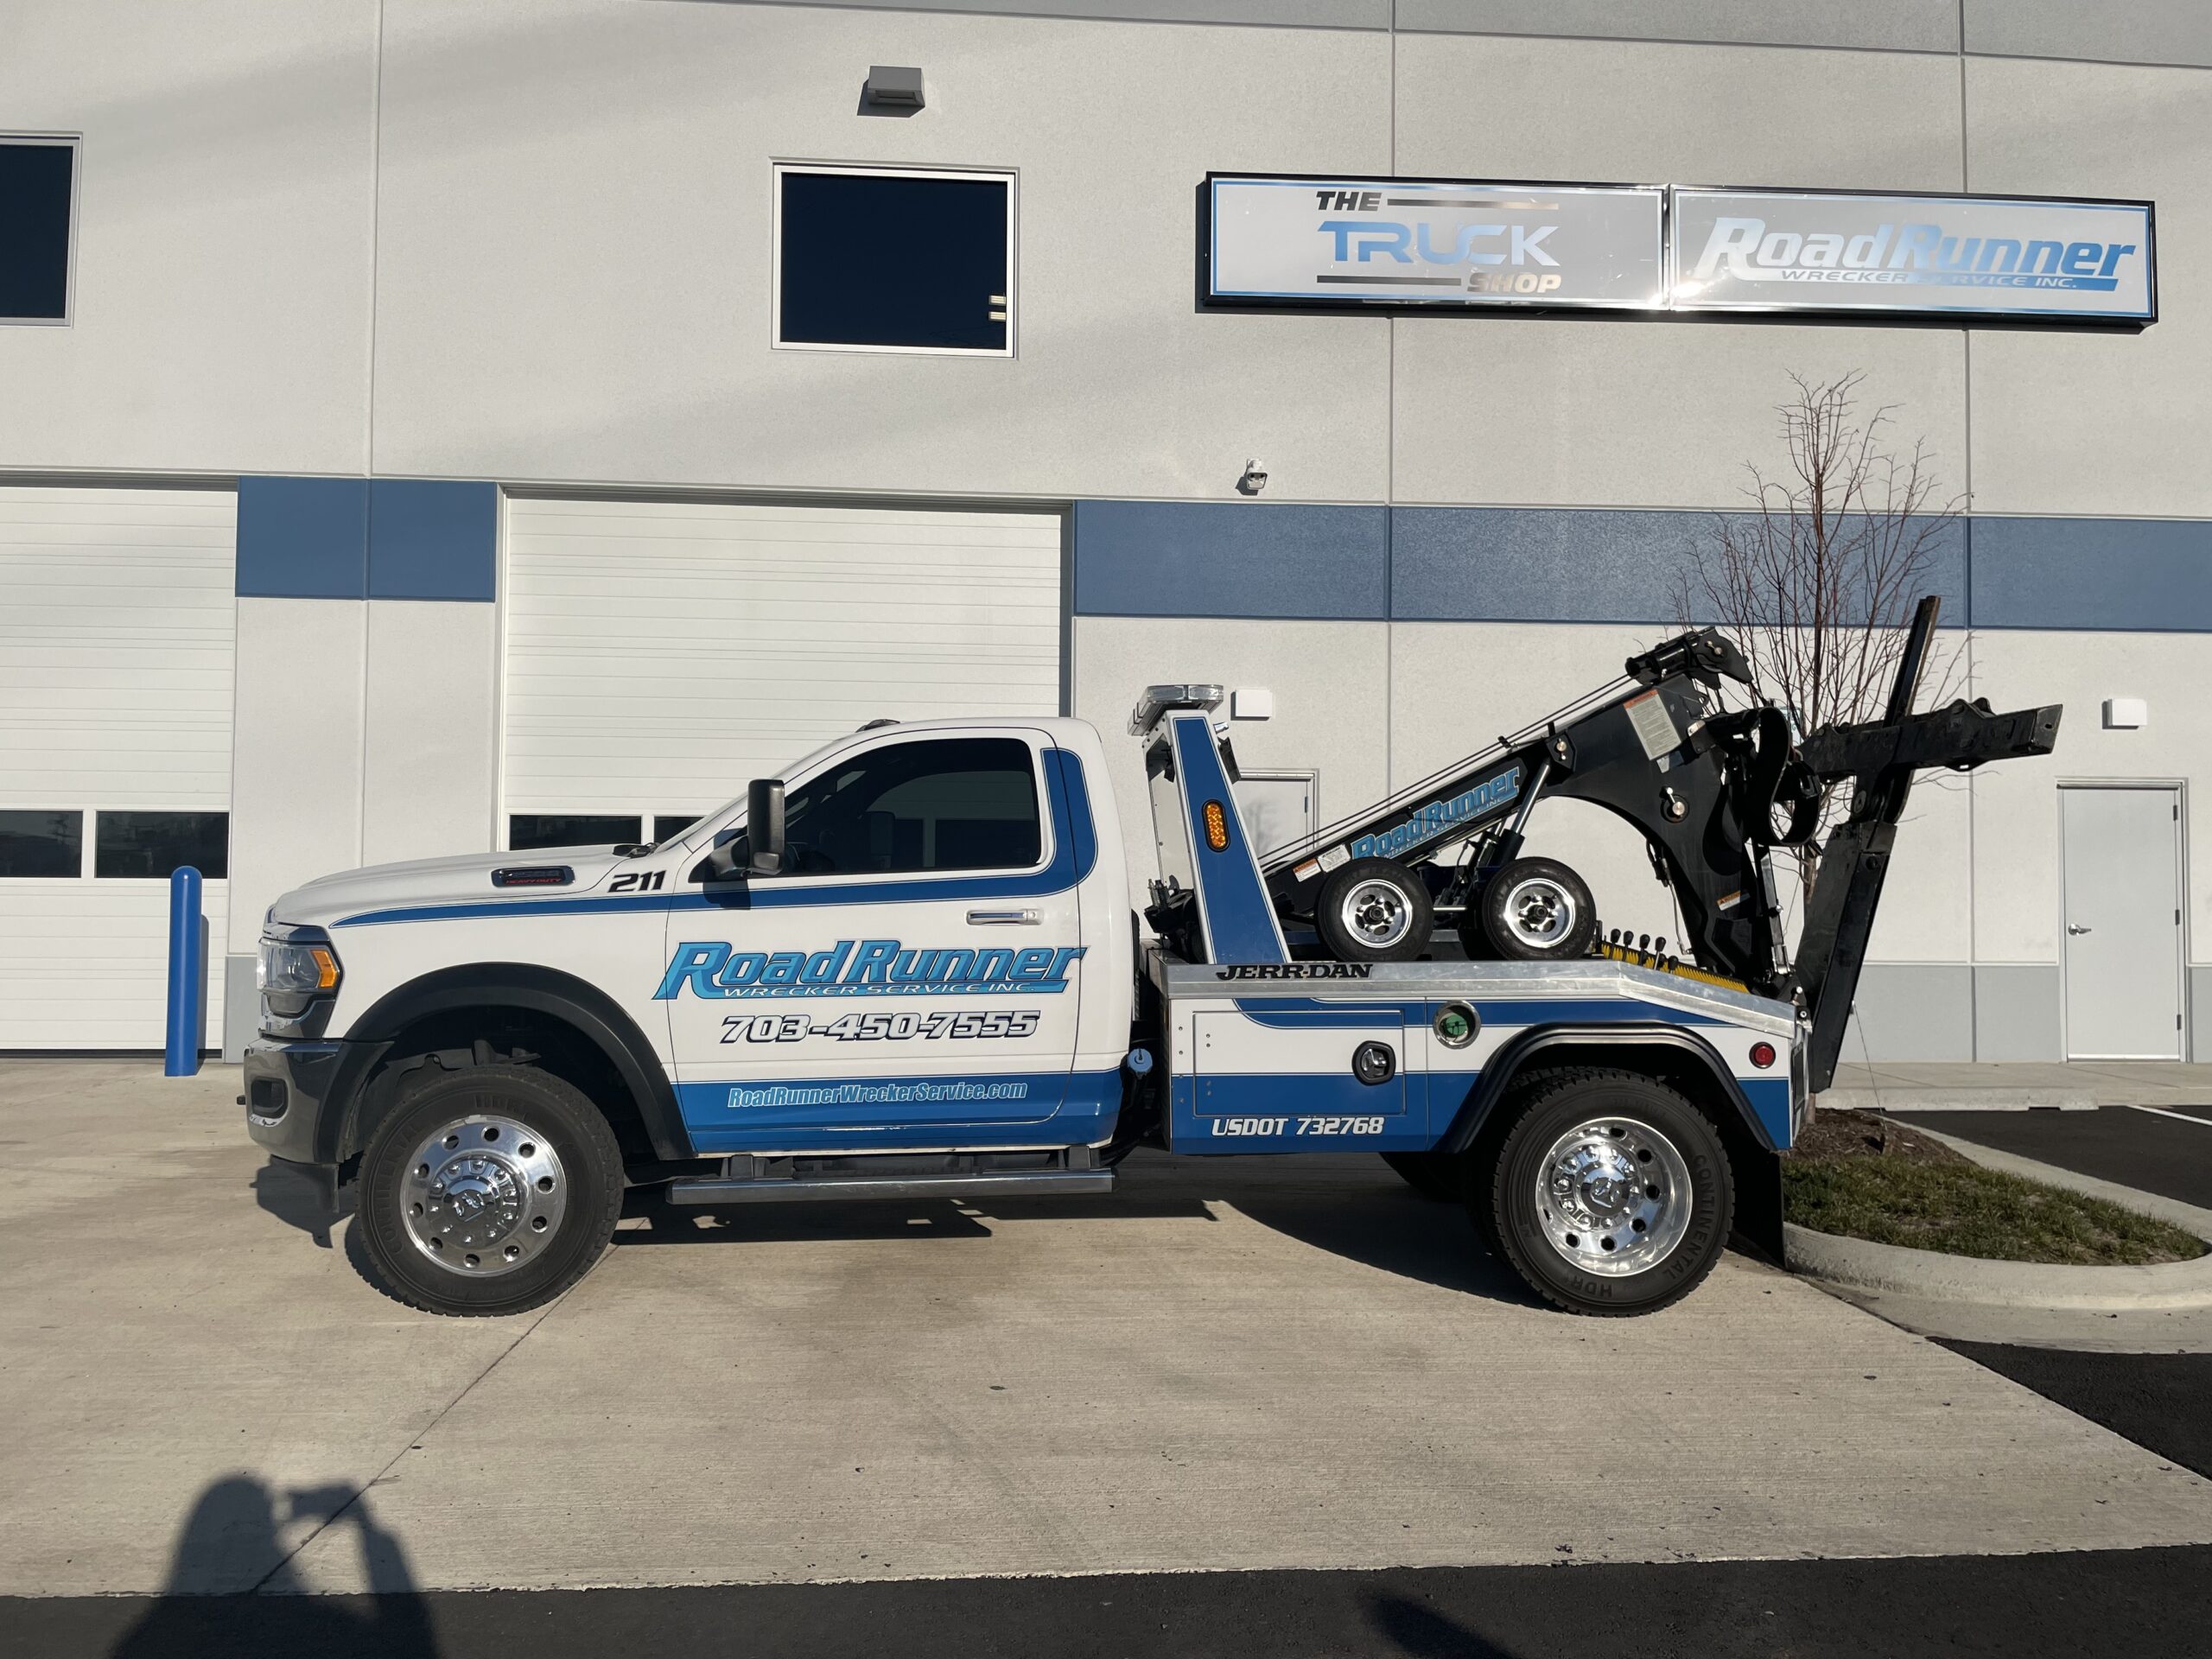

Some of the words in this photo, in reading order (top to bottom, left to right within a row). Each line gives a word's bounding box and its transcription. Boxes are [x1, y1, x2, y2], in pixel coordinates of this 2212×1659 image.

[1316, 191, 1382, 211] THE
[1317, 220, 1561, 266] TRUCK
[1467, 272, 1561, 293] SHOP
[1780, 270, 1910, 283] WRECKER
[2034, 276, 2078, 289] INC.
[607, 870, 667, 893] 211
[1215, 963, 1373, 980] JERR-DAN
[724, 985, 859, 998] WRECKER
[866, 983, 980, 995] SERVICE
[988, 982, 1036, 993] INC.
[719, 1010, 1041, 1044] 703-450-7555
[727, 1082, 1027, 1109] RoadRunnerWreckerService.com
[1211, 1117, 1288, 1136] USDOT
[1295, 1116, 1385, 1135] 732768
[1662, 1154, 1715, 1281] CONTINENTAL
